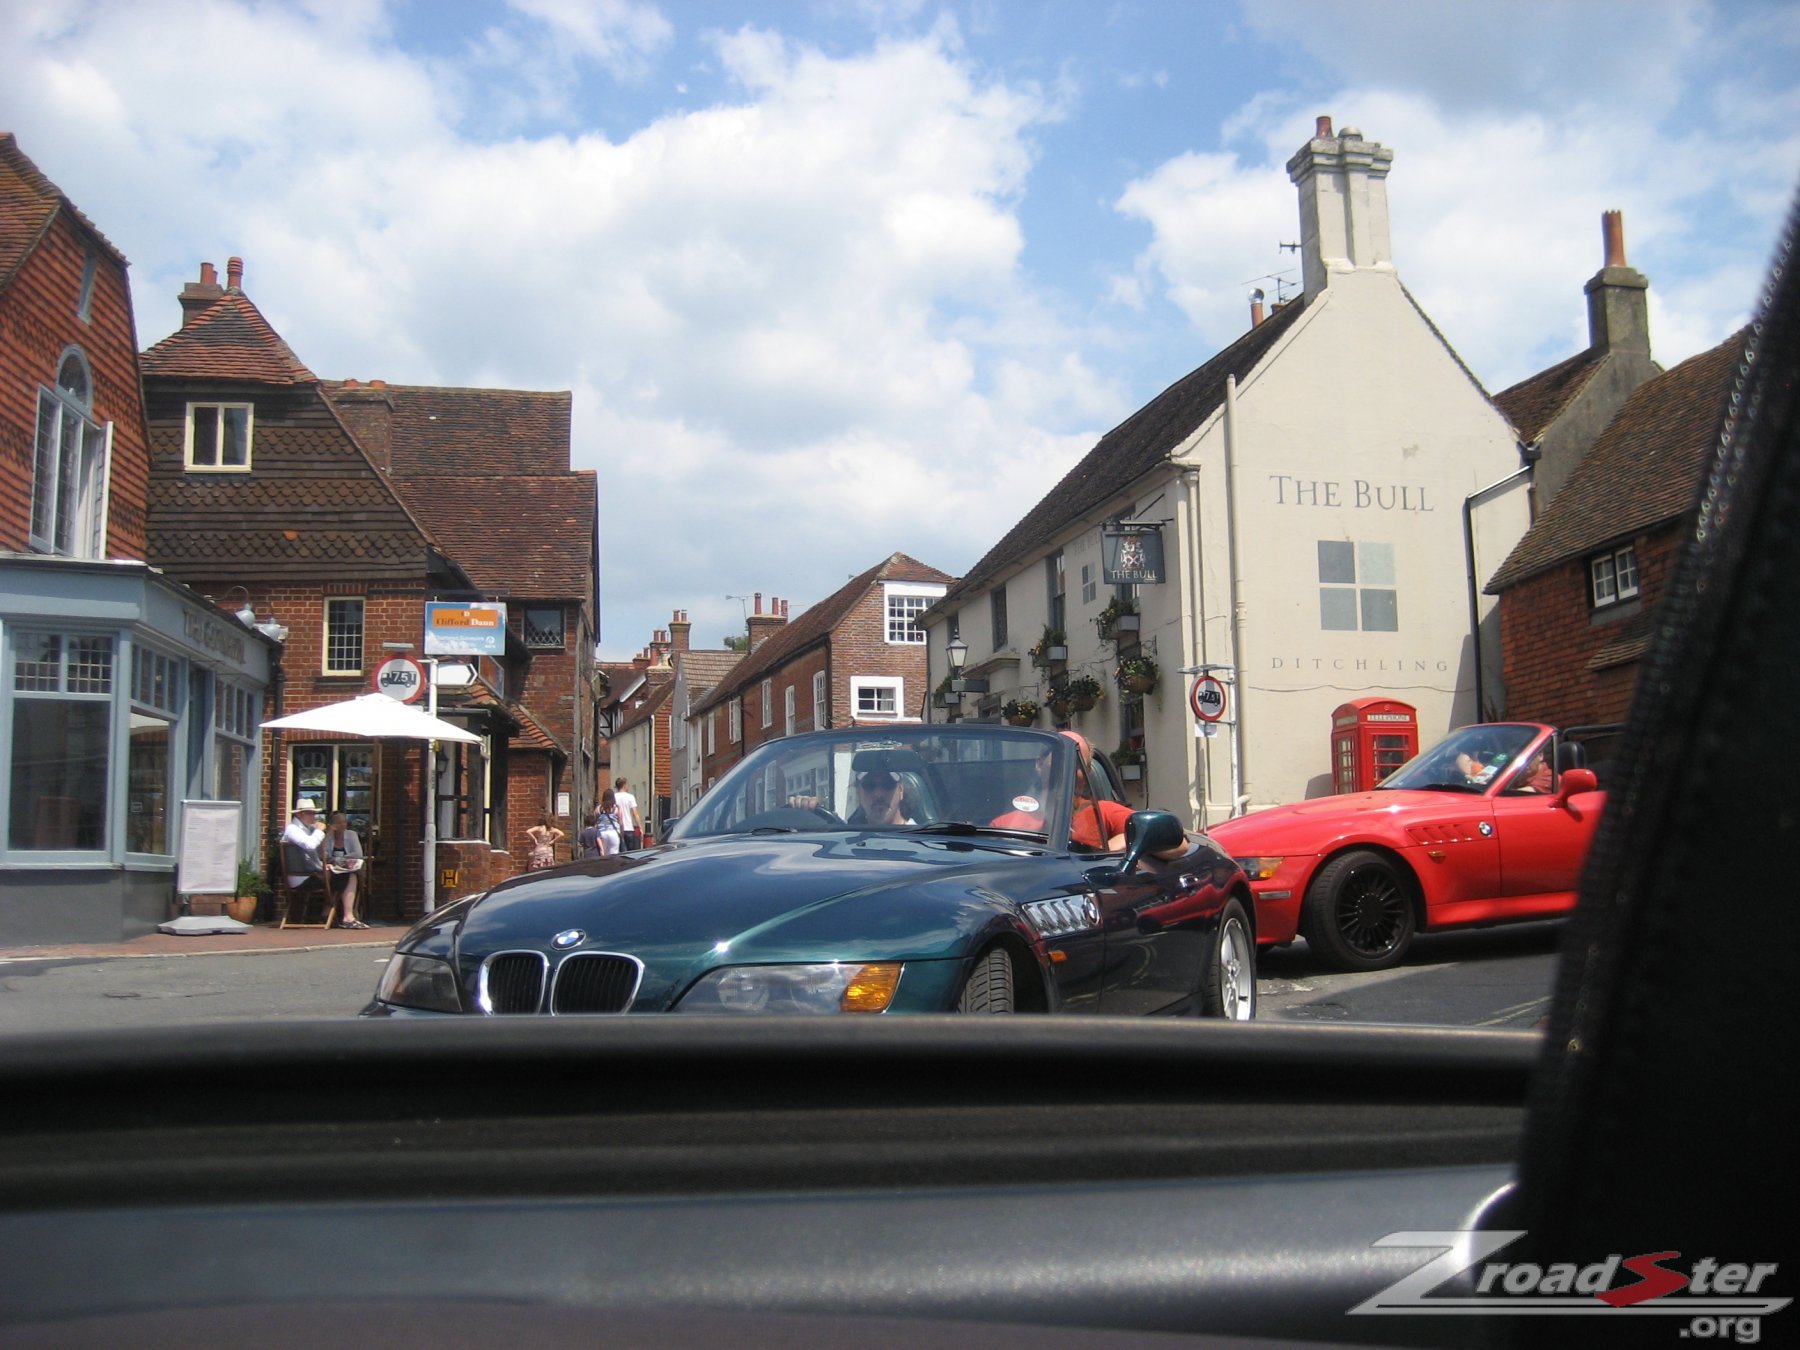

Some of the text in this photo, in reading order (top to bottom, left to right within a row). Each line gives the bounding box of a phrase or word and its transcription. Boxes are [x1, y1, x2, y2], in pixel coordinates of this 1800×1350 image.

[1269, 475, 1434, 512] THE BULL
[1111, 570, 1157, 579] THE BULL
[436, 617, 495, 626] Clifford Dann
[1271, 657, 1448, 671] DITCHLING
[393, 671, 416, 682] 7.5T
